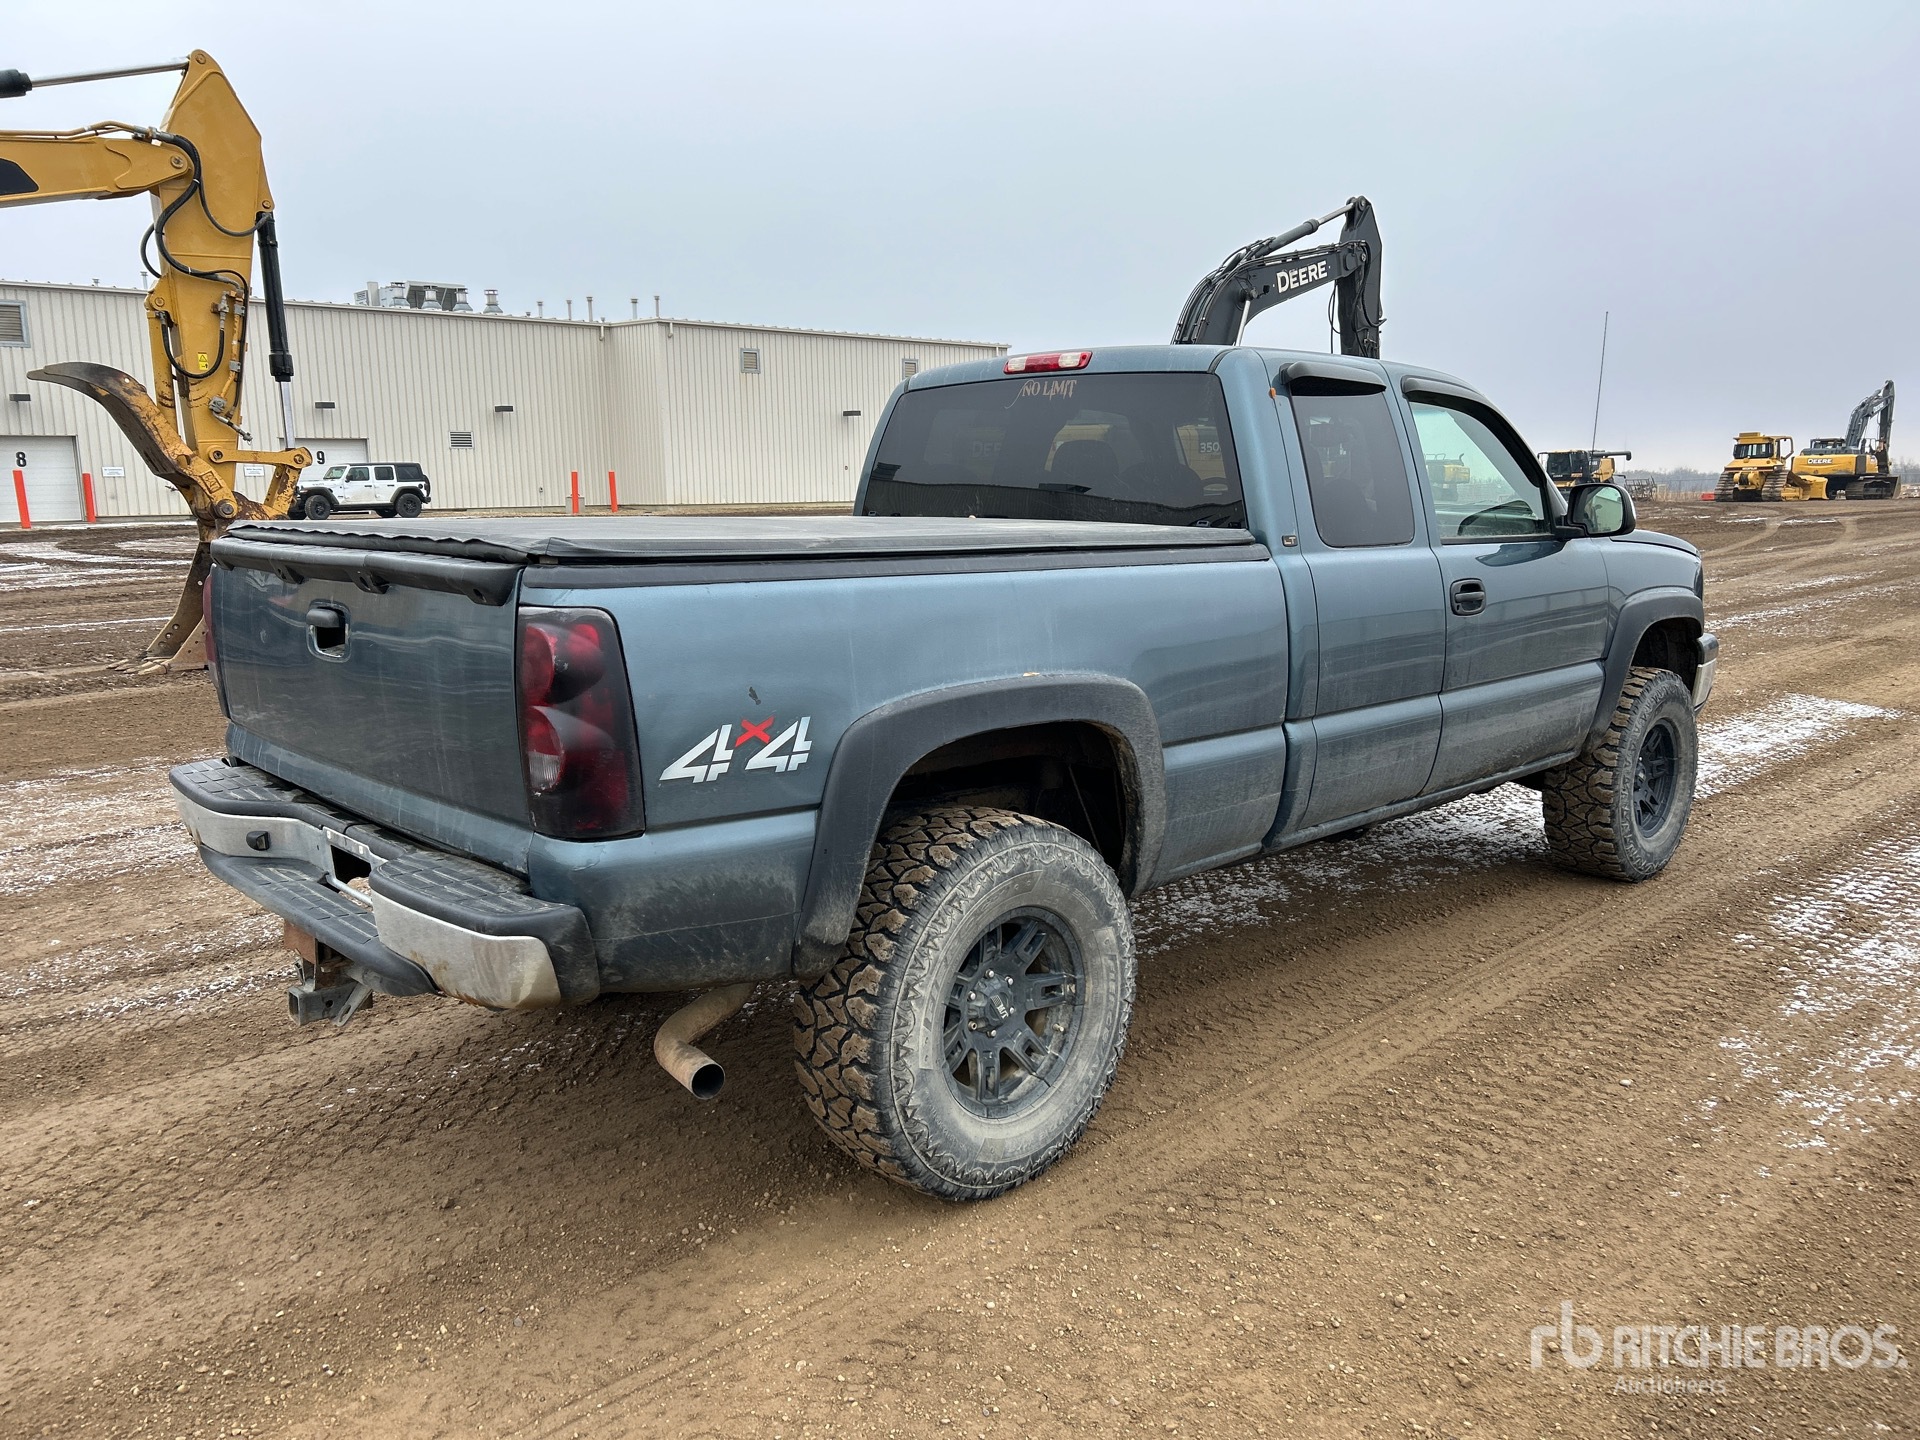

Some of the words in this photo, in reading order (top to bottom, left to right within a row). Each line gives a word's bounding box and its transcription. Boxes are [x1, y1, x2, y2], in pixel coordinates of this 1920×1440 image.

[1276, 260, 1328, 293] DEERE
[1043, 380, 1077, 400] LIMIT
[1199, 441, 1222, 453] 350
[15, 451, 27, 467] 8
[316, 451, 325, 464] 9
[204, 472, 219, 492] CAT
[1284, 537, 1296, 545] LT
